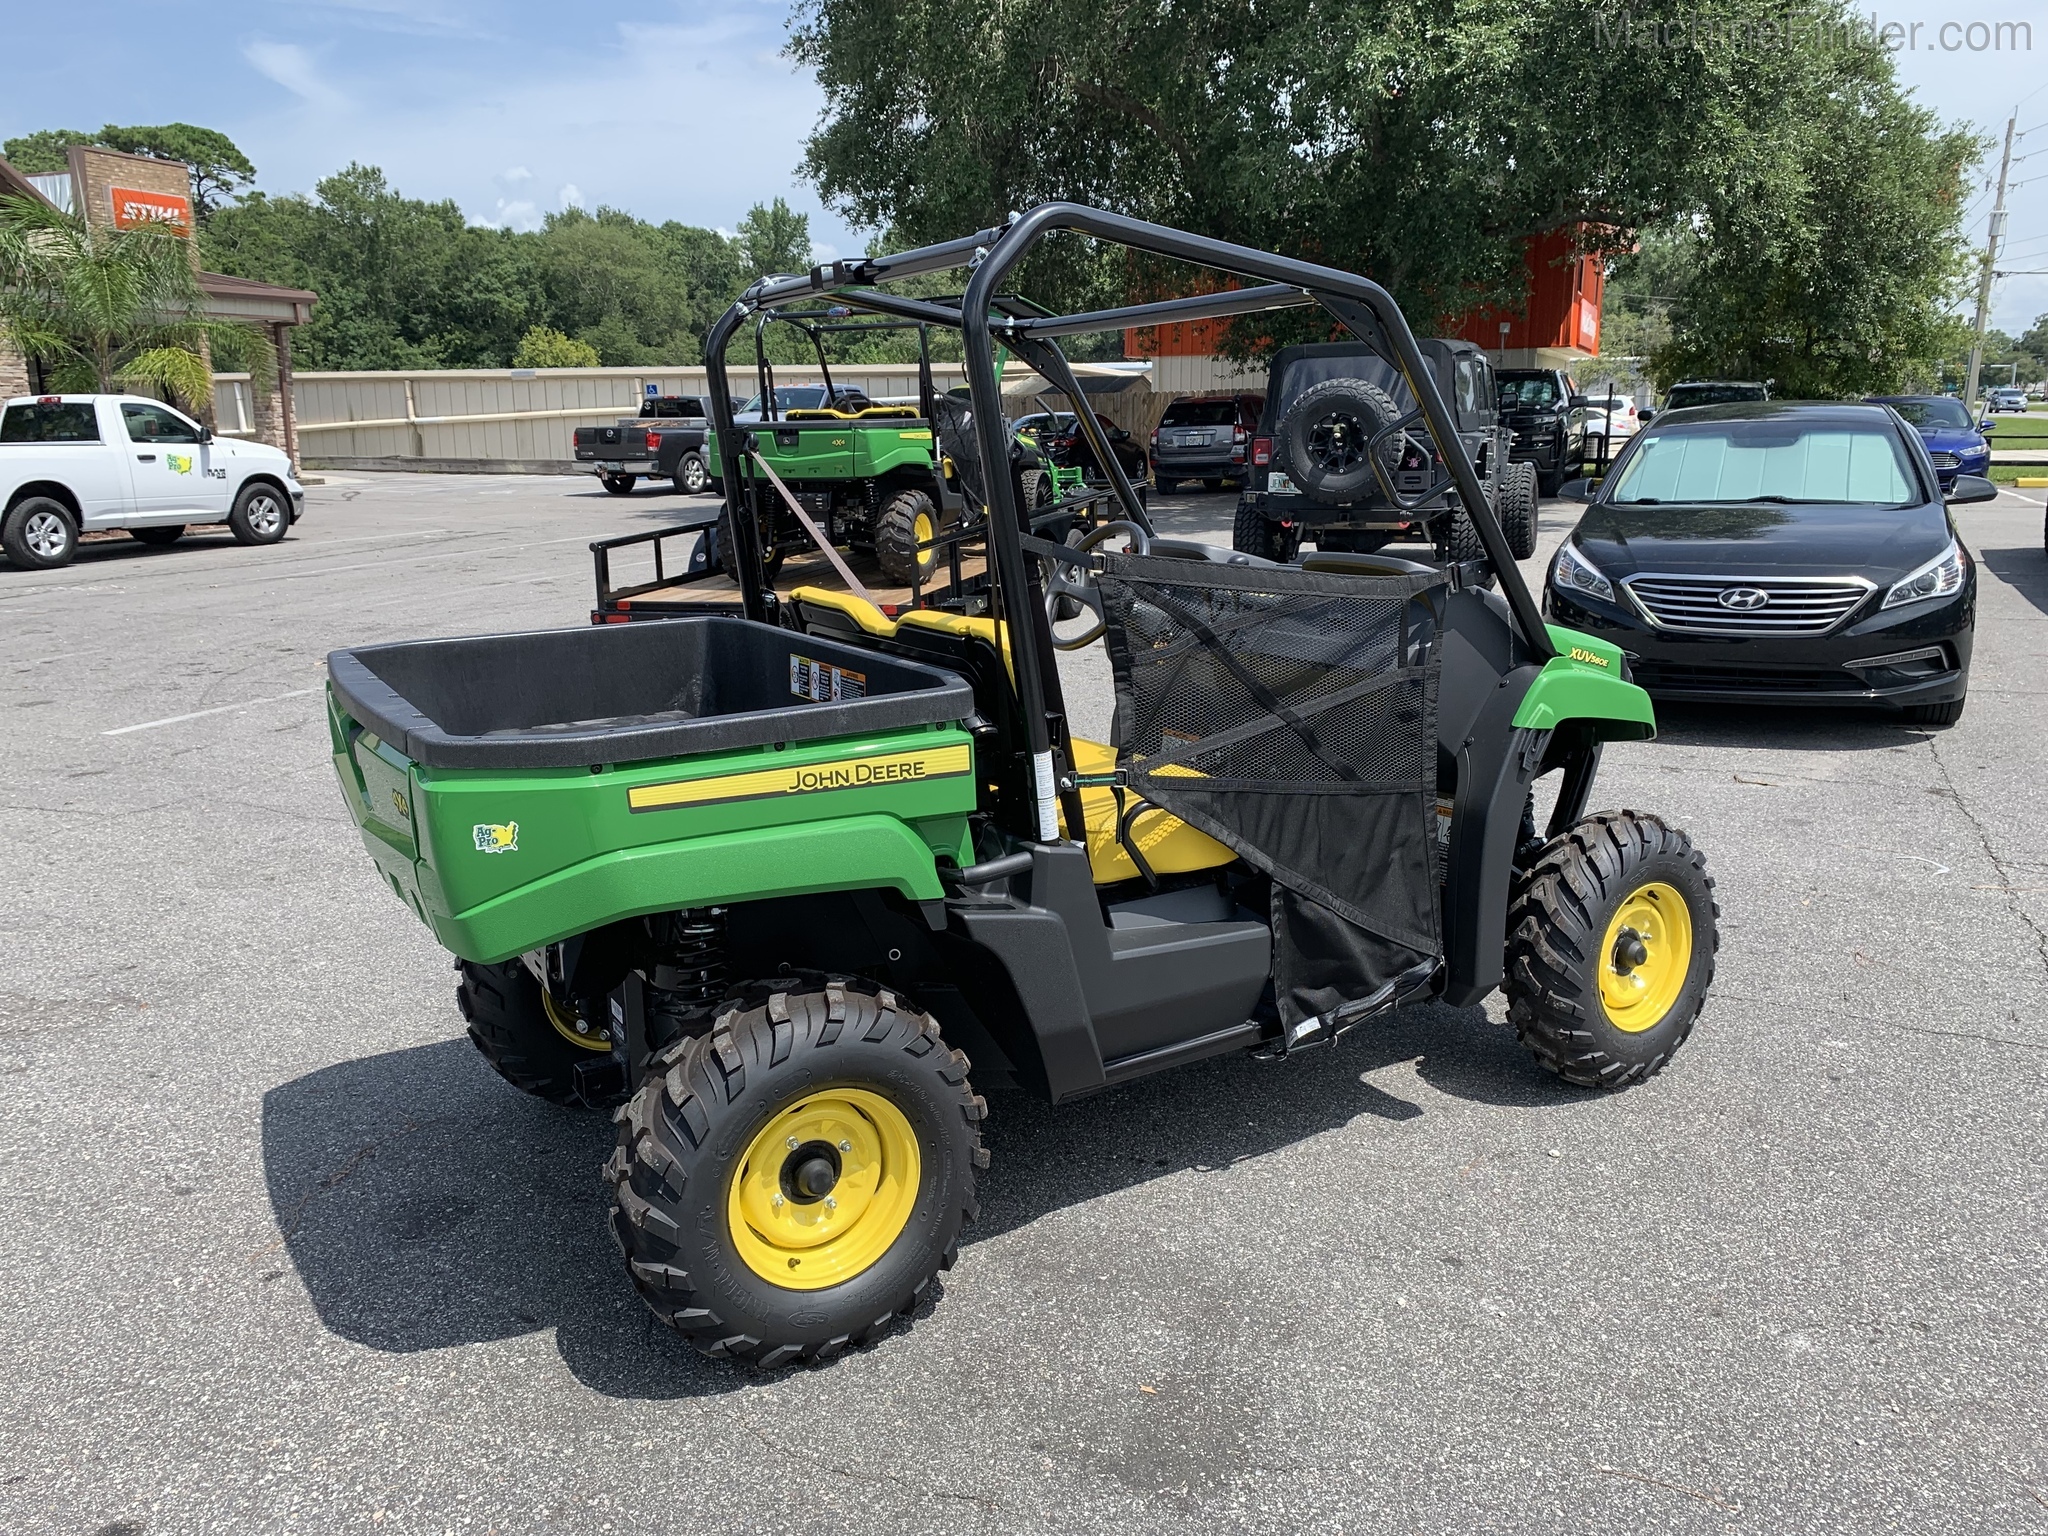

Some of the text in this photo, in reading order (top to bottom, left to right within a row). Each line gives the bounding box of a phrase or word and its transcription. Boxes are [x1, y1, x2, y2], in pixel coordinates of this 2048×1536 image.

[121, 201, 186, 225] STIHL
[788, 761, 926, 790] JOHN DEERE
[477, 836, 499, 847] Pro
